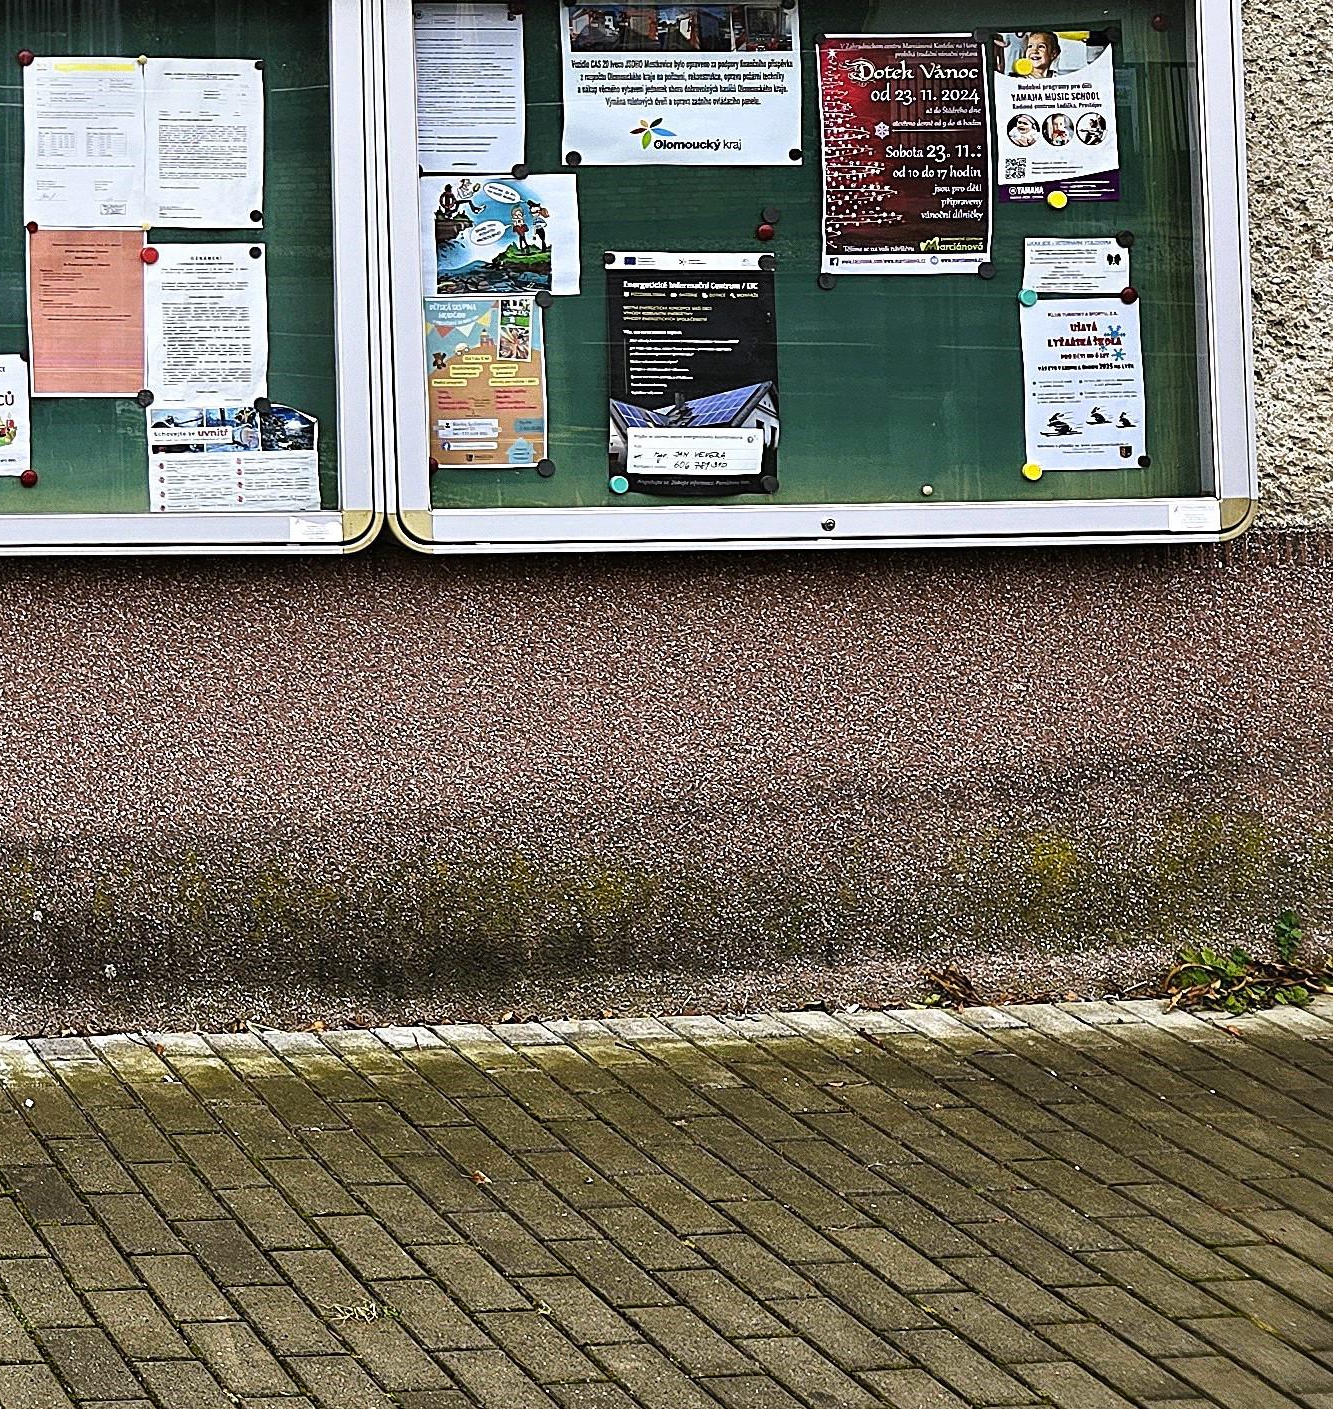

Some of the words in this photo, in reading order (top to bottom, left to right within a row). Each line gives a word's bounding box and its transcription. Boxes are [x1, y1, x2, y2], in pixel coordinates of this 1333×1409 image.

[839, 57, 914, 87] Dotek
[920, 62, 978, 79] Vánoc
[871, 83, 891, 101] od
[895, 90, 916, 105] 23.
[922, 90, 937, 100] 11.
[942, 89, 980, 104] 2024
[1011, 93, 1042, 101] YAMAHA
[1071, 92, 1100, 100] SCHOOL
[653, 139, 721, 151] Olomoucký
[723, 139, 741, 151] kraj
[886, 145, 923, 158] Sobota
[927, 145, 950, 162] 23.
[893, 165, 905, 177] od
[922, 165, 934, 177] do
[950, 165, 981, 177] hodin
[952, 186, 965, 194] pro
[198, 428, 228, 436] uvnitř
